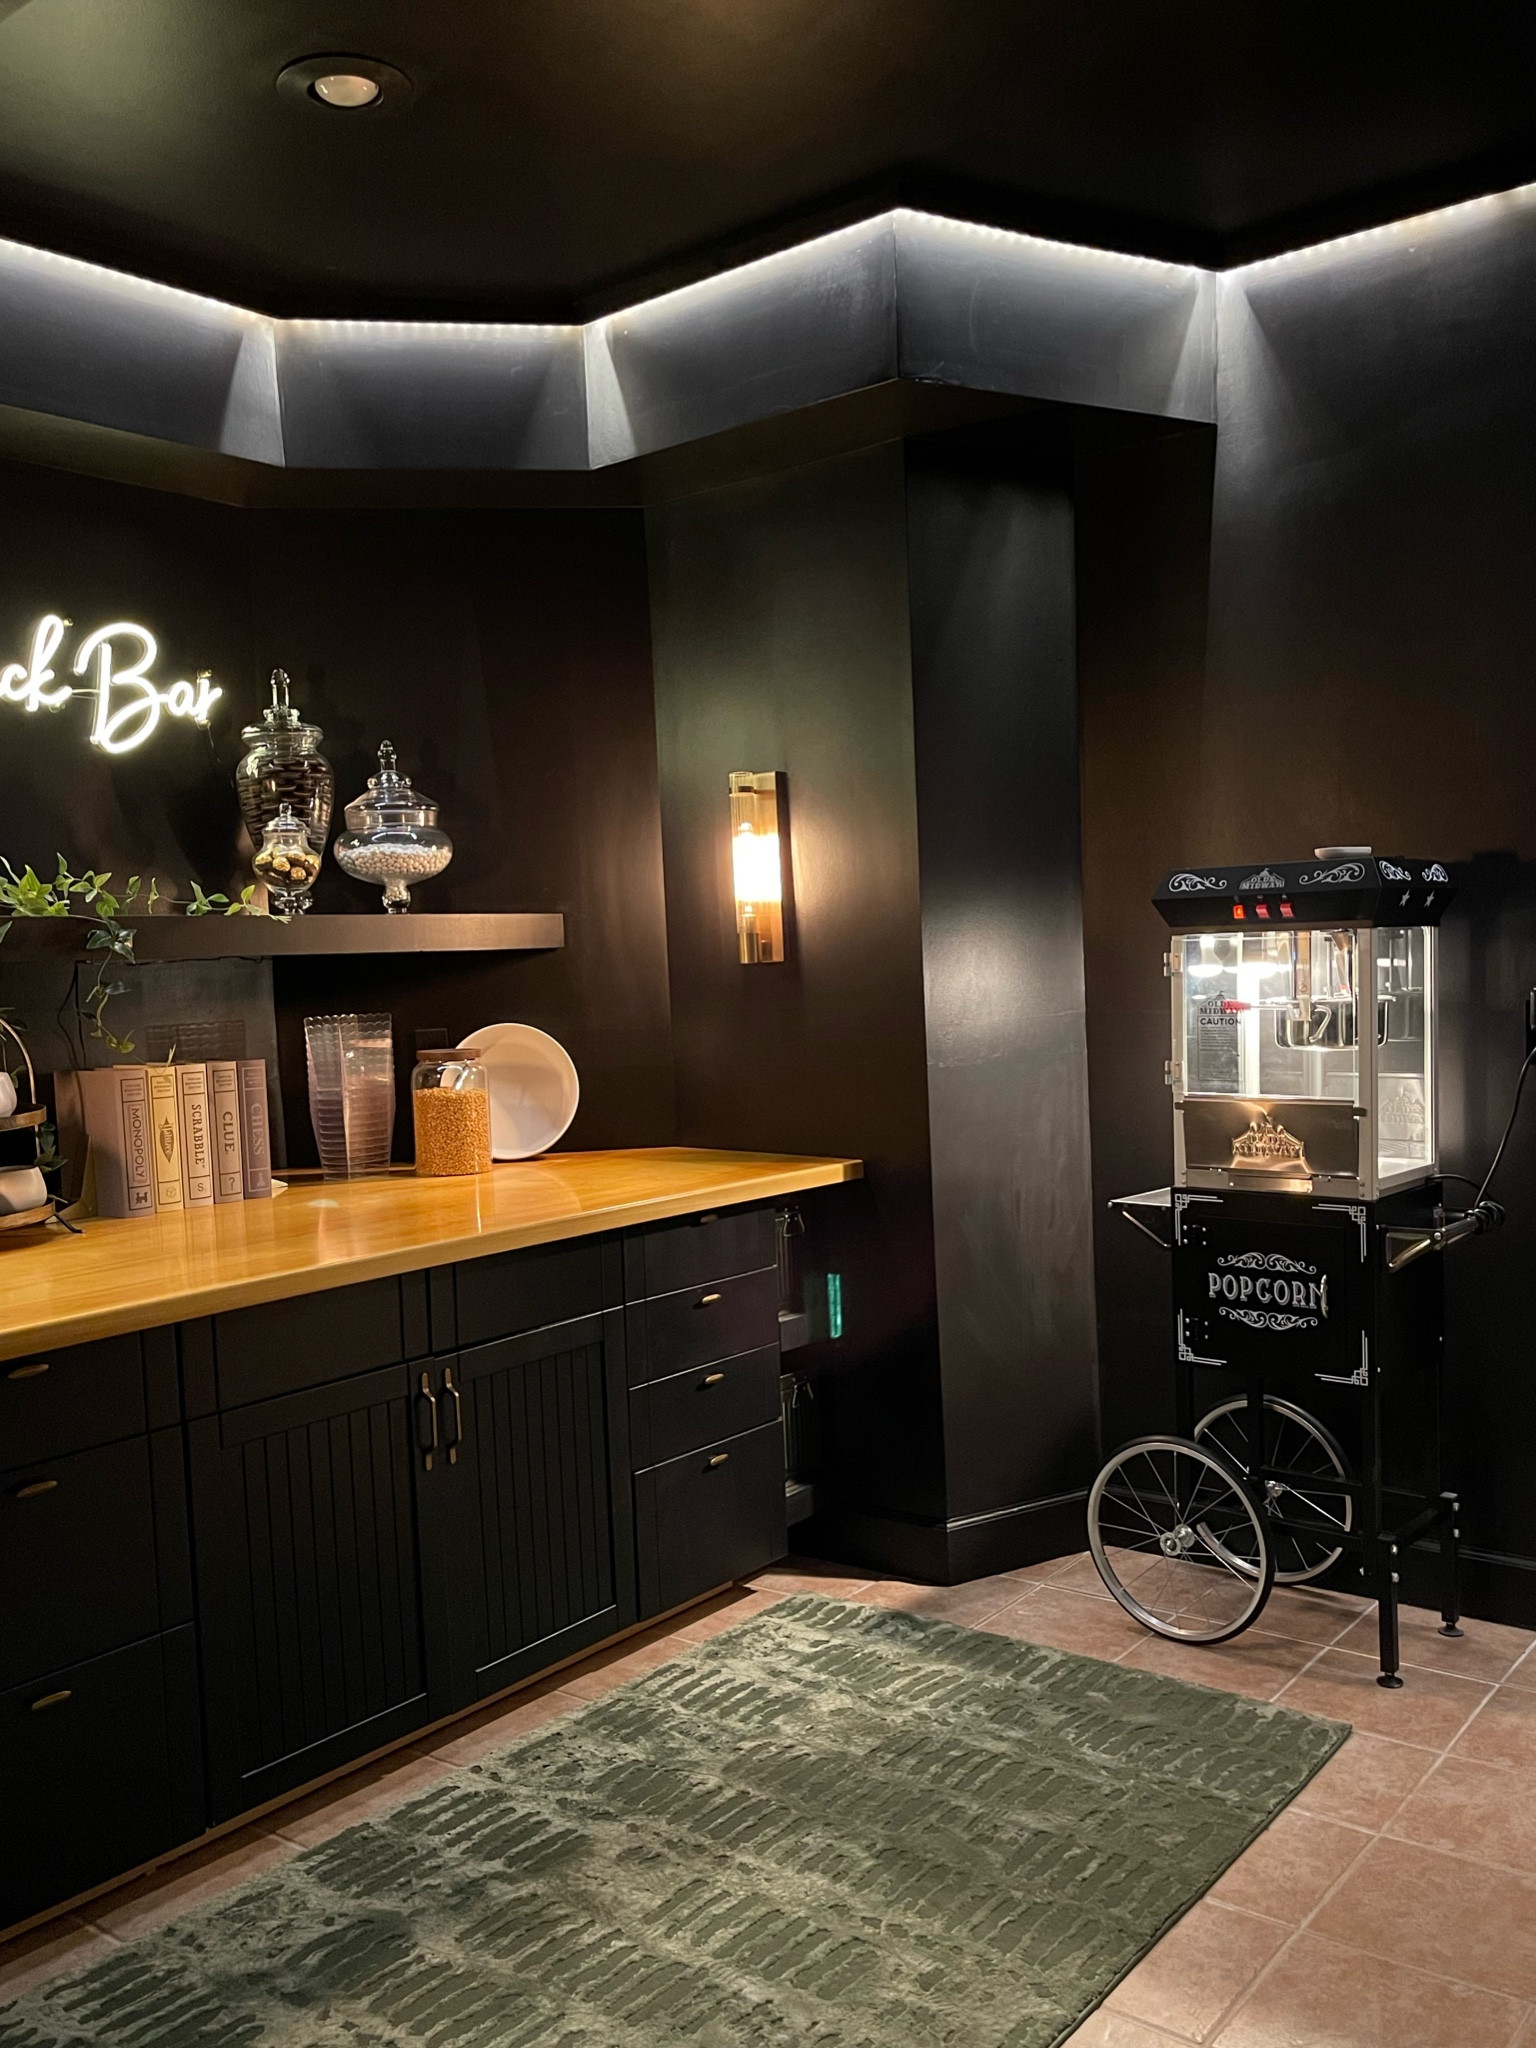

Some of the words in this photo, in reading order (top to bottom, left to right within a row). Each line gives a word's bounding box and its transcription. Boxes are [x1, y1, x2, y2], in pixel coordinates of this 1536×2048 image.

[73, 621, 223, 755] Bar
[1199, 1017, 1242, 1026] CAUTION
[131, 1107, 146, 1178] MONOPOLY
[191, 1104, 205, 1165] SCRABBLE
[222, 1111, 235, 1152] CLUE
[251, 1103, 265, 1155] CHESS
[1207, 1272, 1324, 1310] POPCORN
